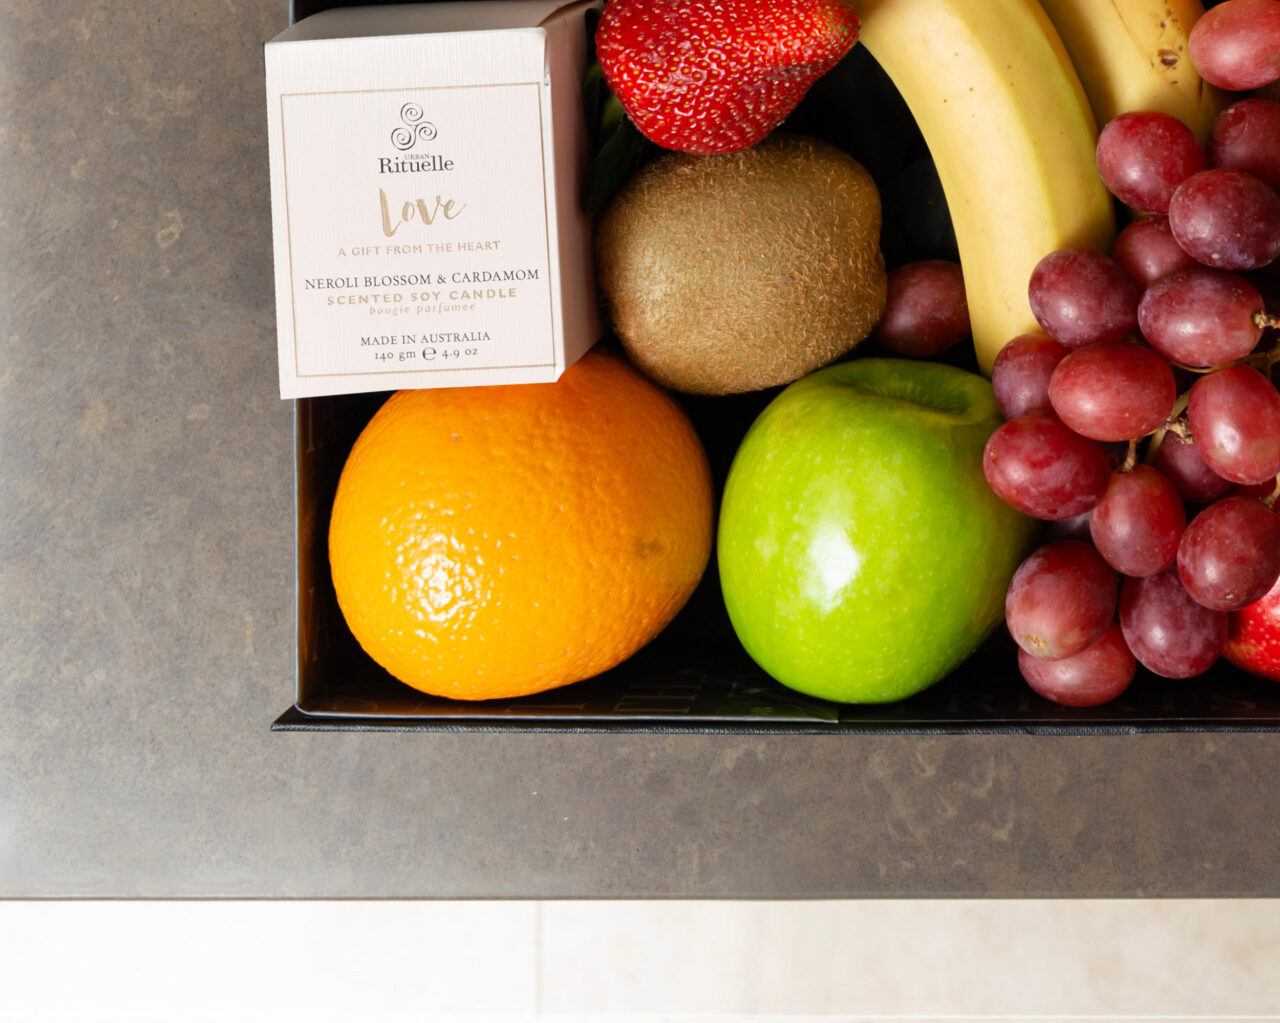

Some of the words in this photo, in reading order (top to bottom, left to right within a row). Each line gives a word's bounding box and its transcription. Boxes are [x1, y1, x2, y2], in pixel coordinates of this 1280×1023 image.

[378, 155, 455, 174] Rituelle
[379, 187, 468, 238] Love
[338, 248, 347, 257] A
[351, 246, 381, 257] GIFT
[386, 244, 423, 255] FROM
[427, 243, 453, 253] THE
[457, 241, 502, 252] HEART
[304, 277, 359, 290] NEROLI
[364, 273, 432, 287] BLOSSOM
[437, 274, 447, 284] &
[452, 269, 540, 283] CARDAMOM
[327, 293, 403, 305] SCENTED
[410, 291, 441, 302] SOY
[449, 288, 518, 300] CANDLE
[360, 336, 398, 346] MADE
[402, 335, 416, 344] IN
[420, 331, 491, 344] AUSTRALIA
[375, 352, 394, 362] 140
[399, 350, 416, 361] gm
